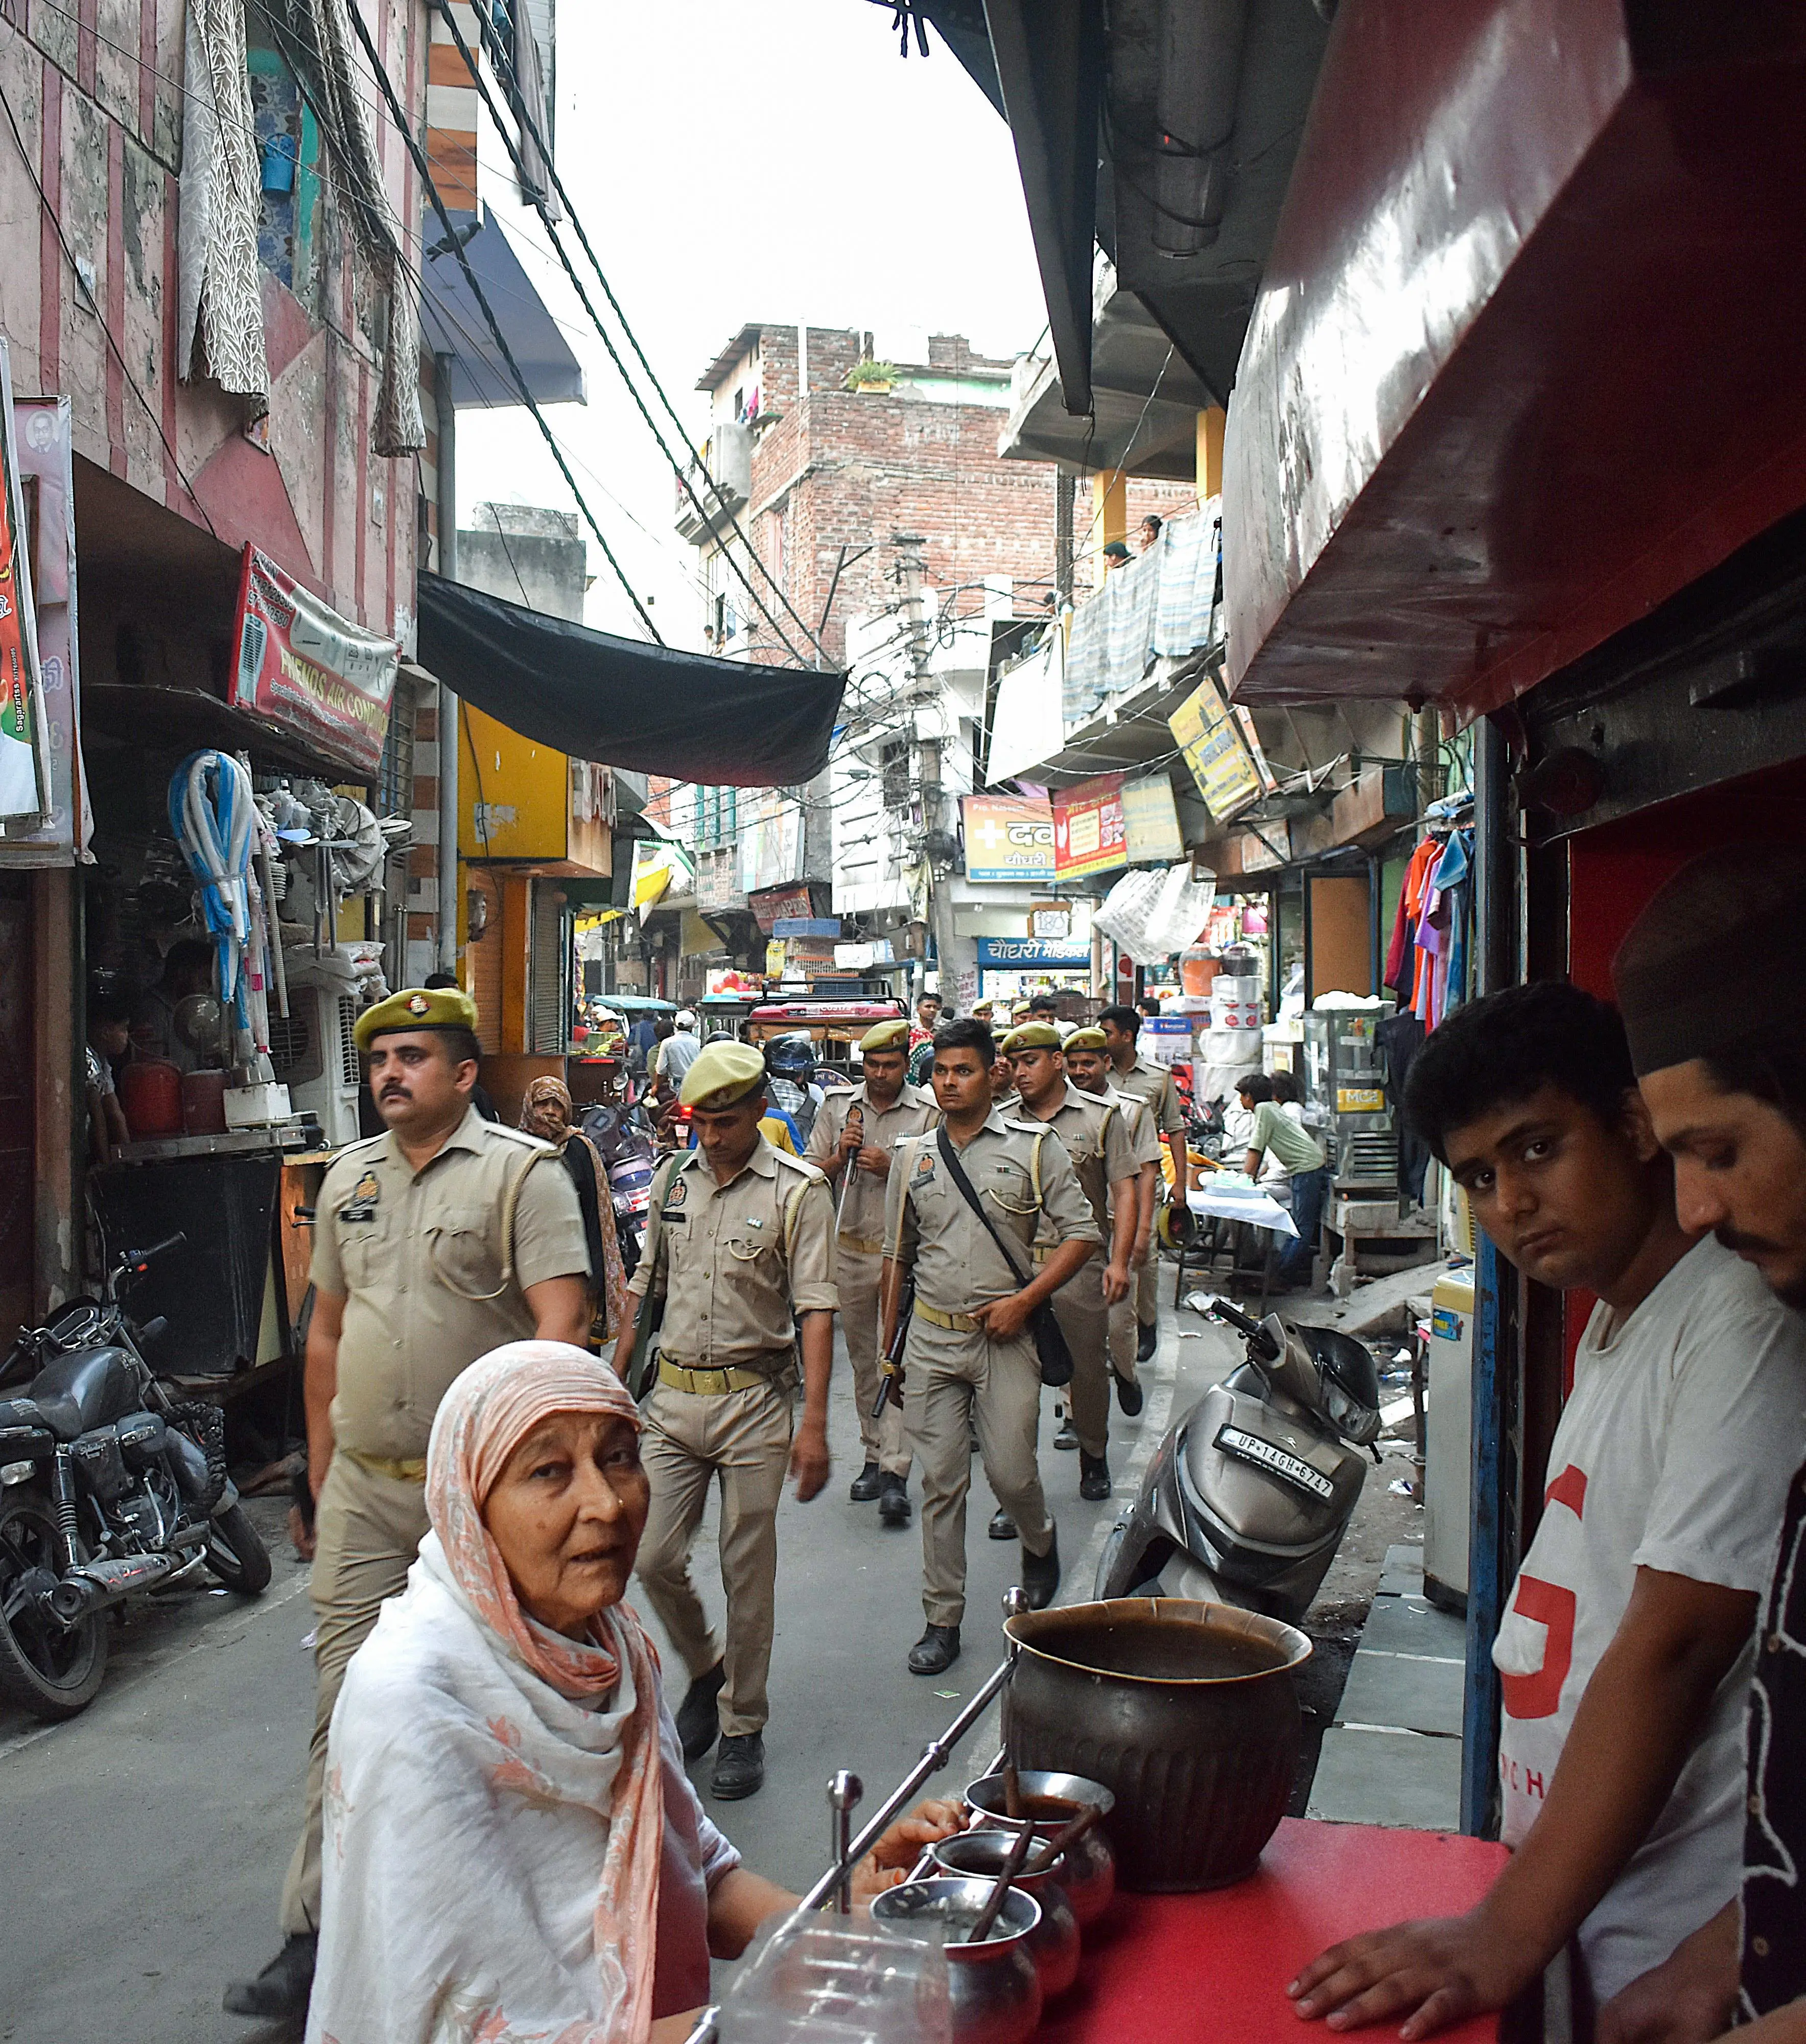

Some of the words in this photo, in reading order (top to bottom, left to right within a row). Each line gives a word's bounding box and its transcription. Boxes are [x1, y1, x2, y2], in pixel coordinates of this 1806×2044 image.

[13, 683, 25, 732] Sagarartss
[327, 682, 345, 713] AIR
[1037, 915, 1066, 931] 180
[988, 939, 1042, 959] चौधरी
[1043, 940, 1090, 959] मेडिकल
